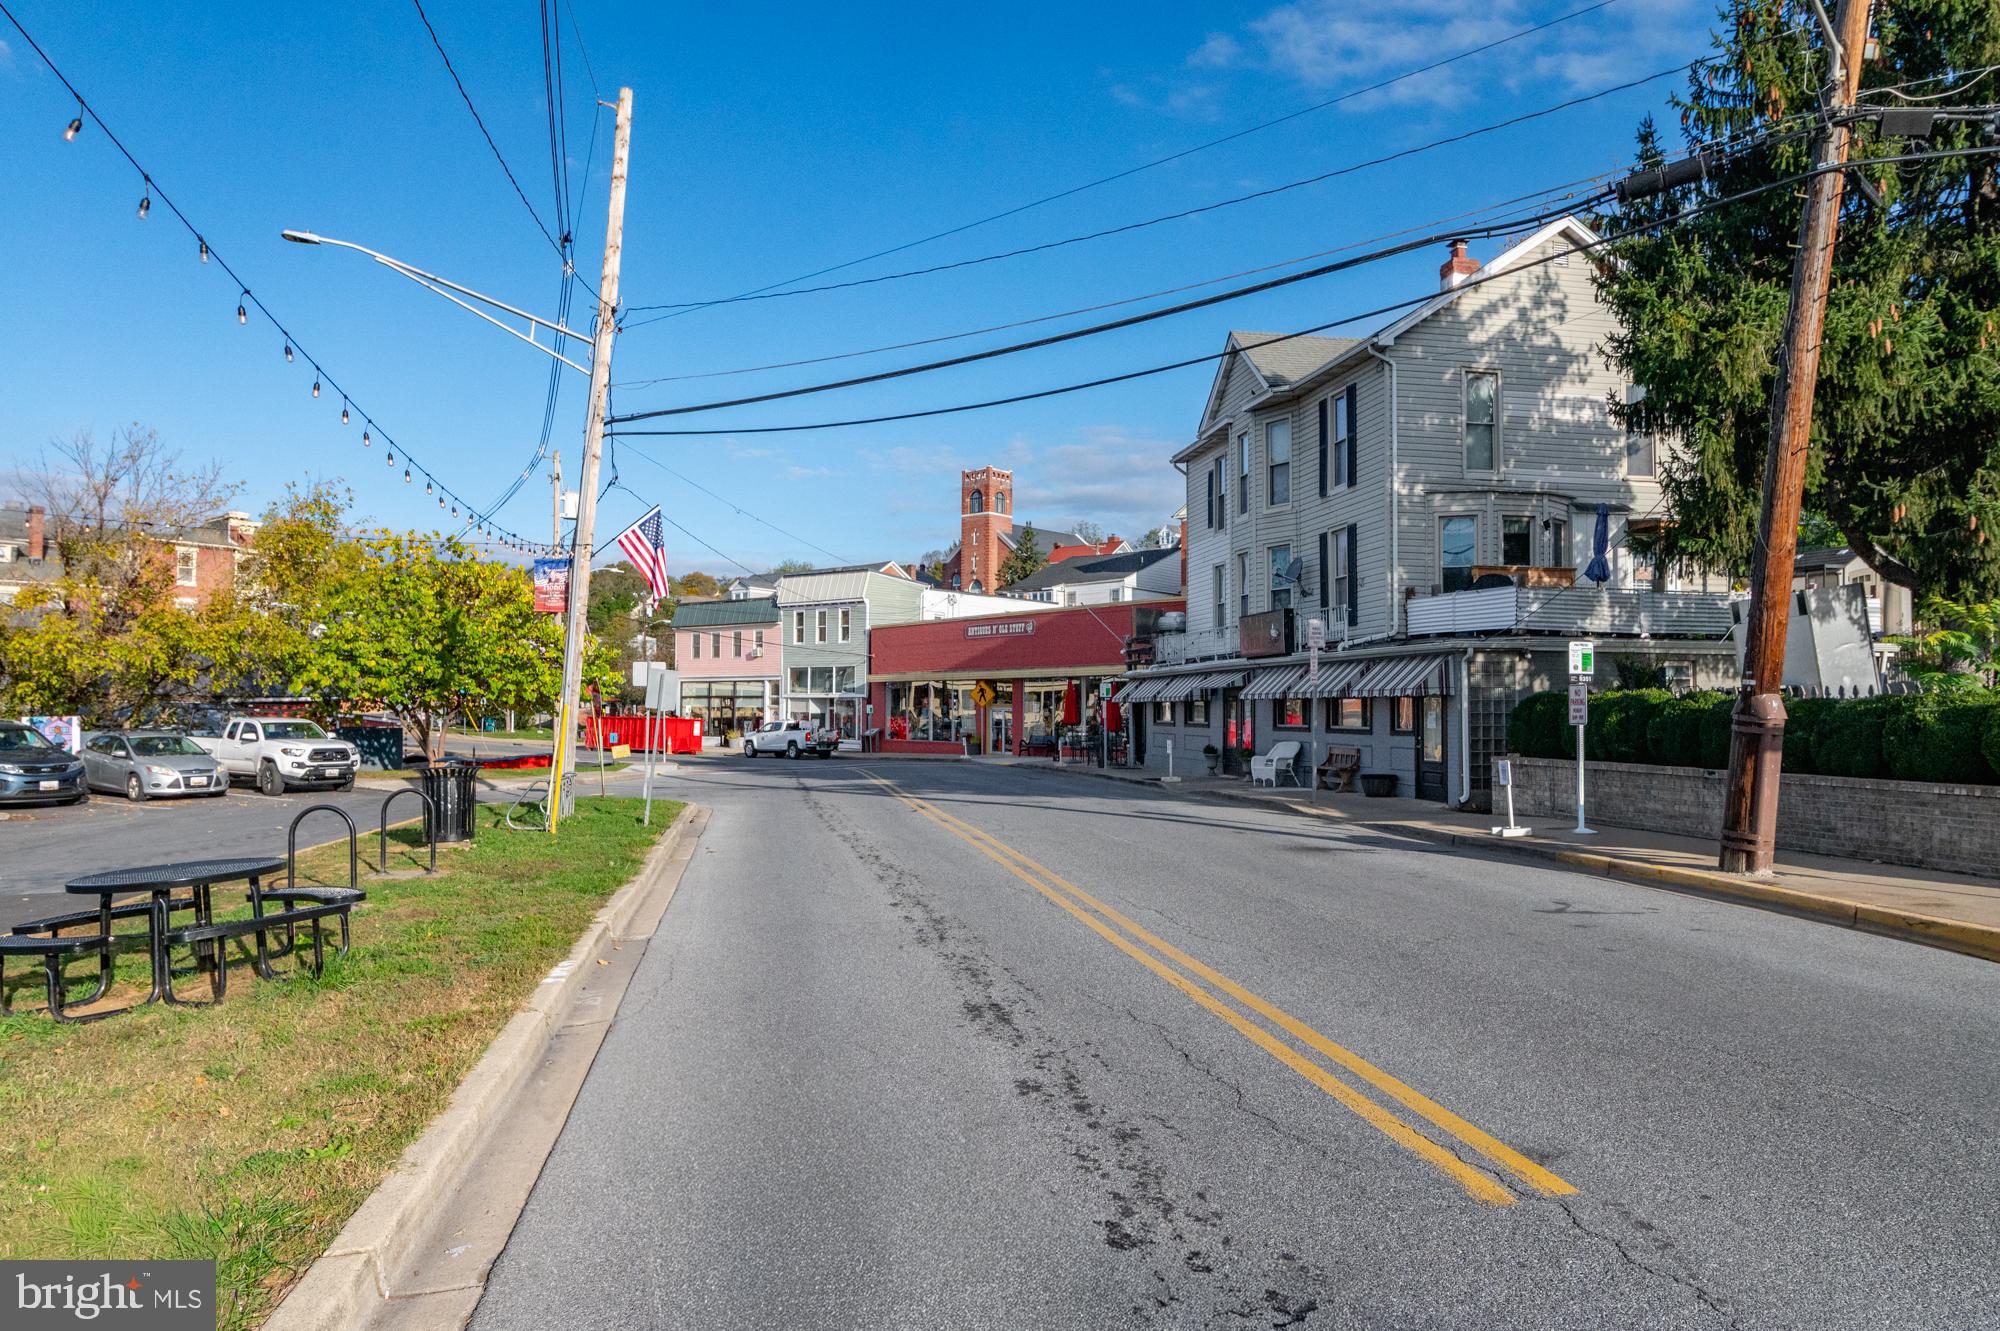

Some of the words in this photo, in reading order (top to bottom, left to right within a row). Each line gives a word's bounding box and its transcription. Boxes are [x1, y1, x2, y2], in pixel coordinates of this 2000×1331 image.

[967, 625, 992, 636] ANTIQUES
[1009, 622, 1025, 633] STUFF
[1574, 689, 1582, 697] NO
